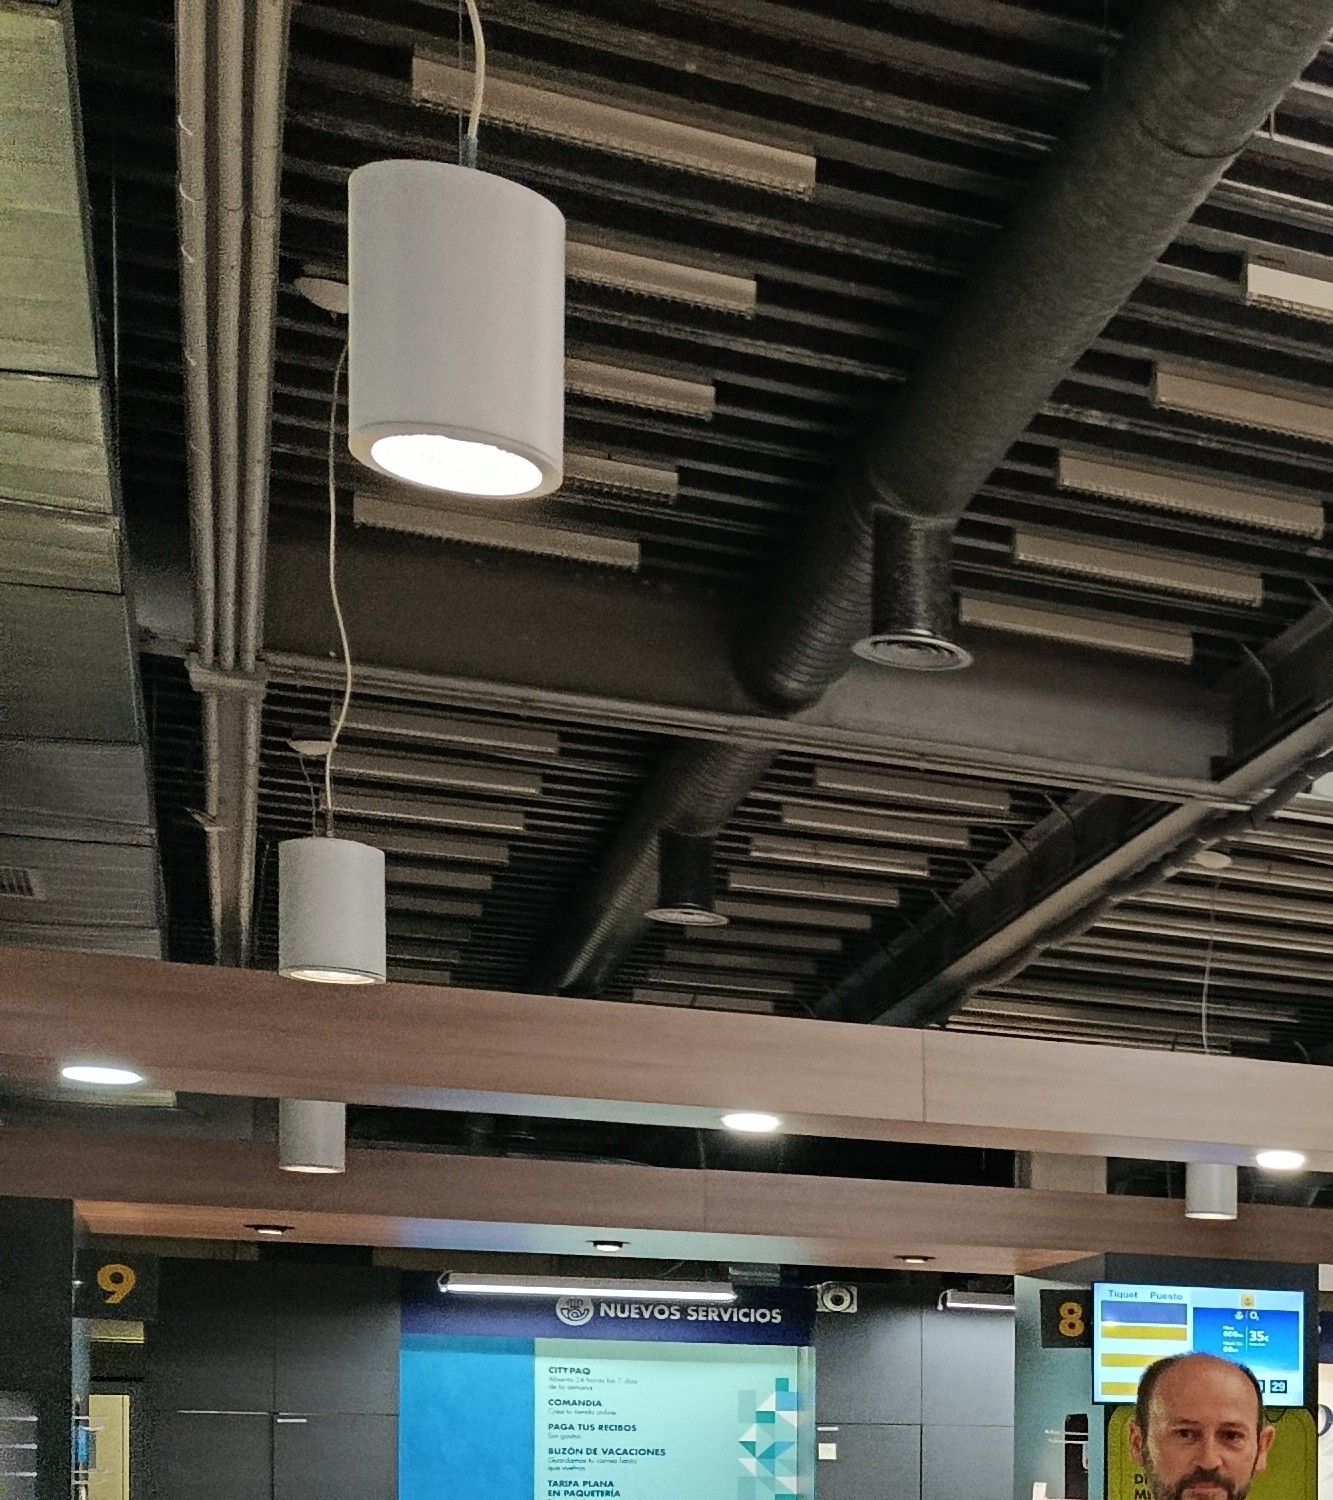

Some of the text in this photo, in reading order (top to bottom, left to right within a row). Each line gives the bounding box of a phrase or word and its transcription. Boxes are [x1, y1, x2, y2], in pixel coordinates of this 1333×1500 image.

[97, 1264, 136, 1304] 9
[1107, 1289, 1183, 1301] Tiquet Puesto
[600, 1302, 782, 1324] NUEVOS SERVICIOS
[1059, 1302, 1084, 1337] 8
[1271, 1382, 1286, 1392] 29
[548, 1447, 583, 1455] BUZÓN
[601, 1448, 666, 1456] VACACIONES
[582, 1480, 614, 1488] PLANA
